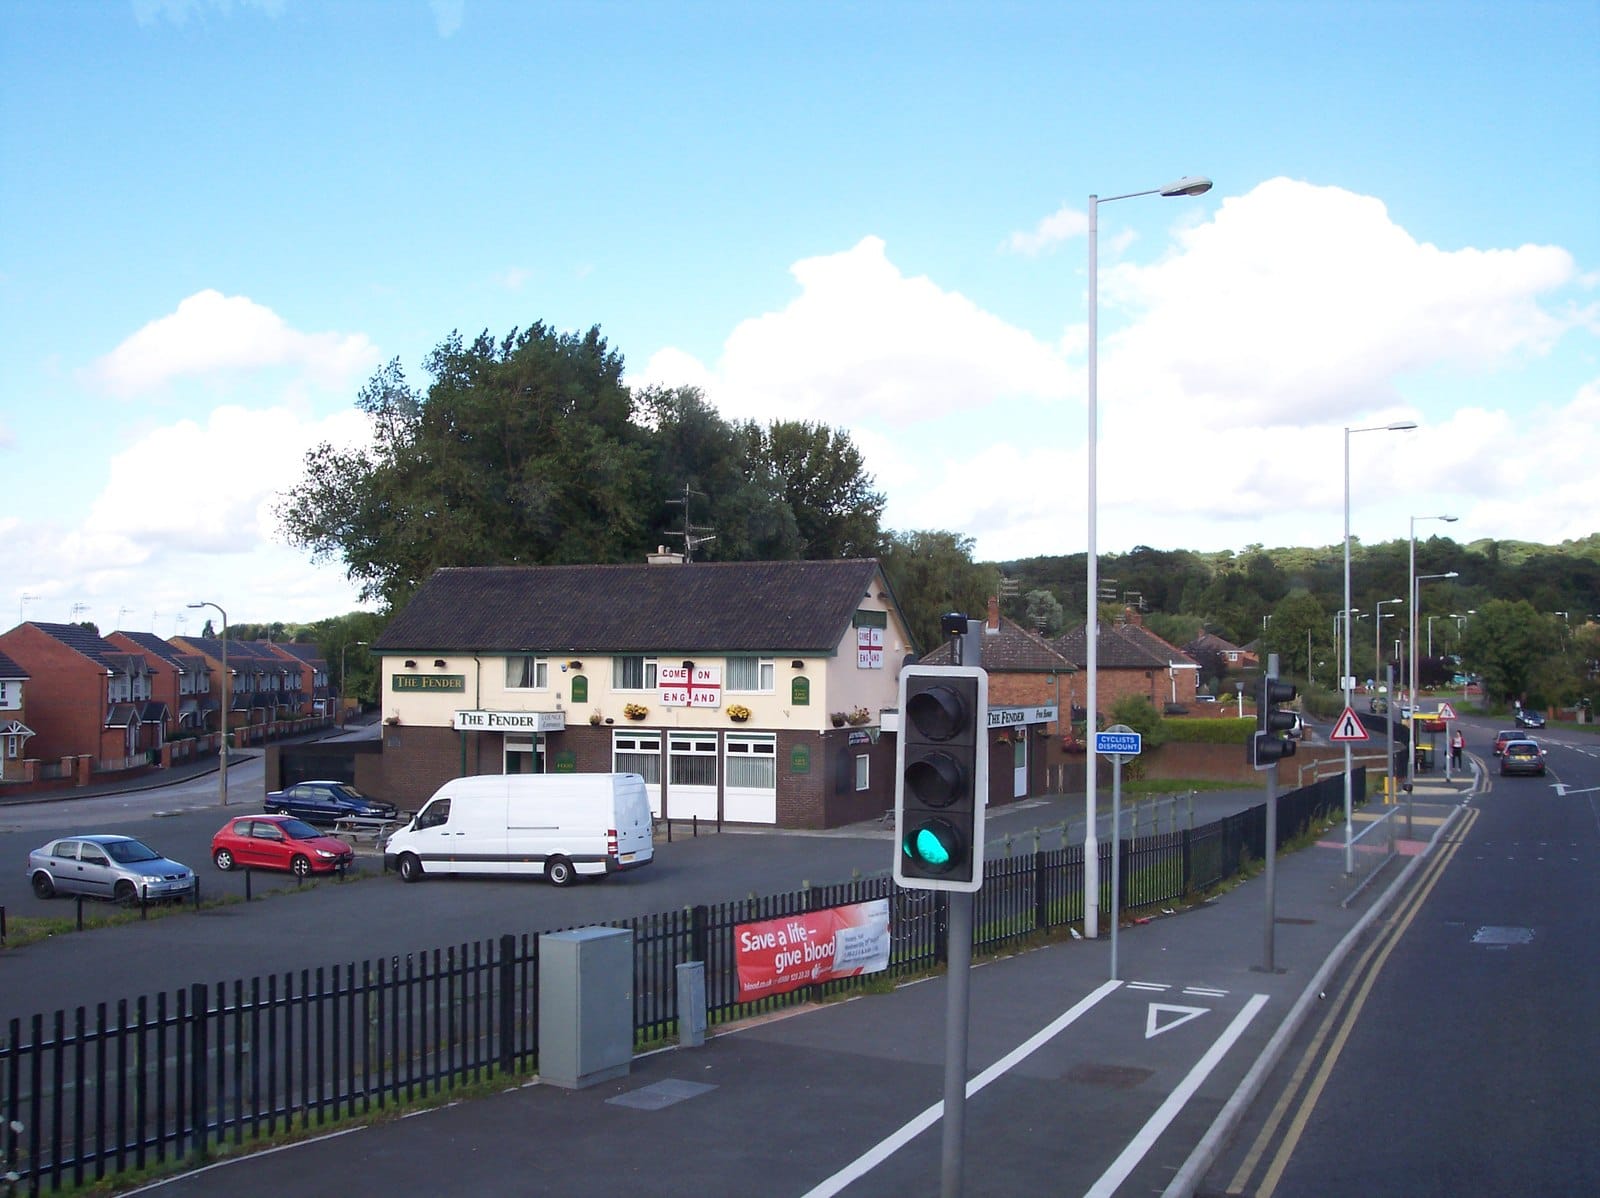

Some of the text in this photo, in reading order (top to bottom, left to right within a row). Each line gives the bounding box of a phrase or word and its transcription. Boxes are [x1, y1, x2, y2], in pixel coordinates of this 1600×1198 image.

[662, 669, 710, 679] COME ON
[396, 676, 462, 689] THE FENDER
[459, 713, 534, 727] THE FENDER
[987, 712, 1001, 725] THE
[1001, 711, 1025, 724] FENDER
[1098, 743, 1138, 751] DISMOUNT
[741, 931, 776, 952] Save
[777, 930, 788, 946] a
[775, 946, 802, 974] give
[803, 935, 836, 963] blood
